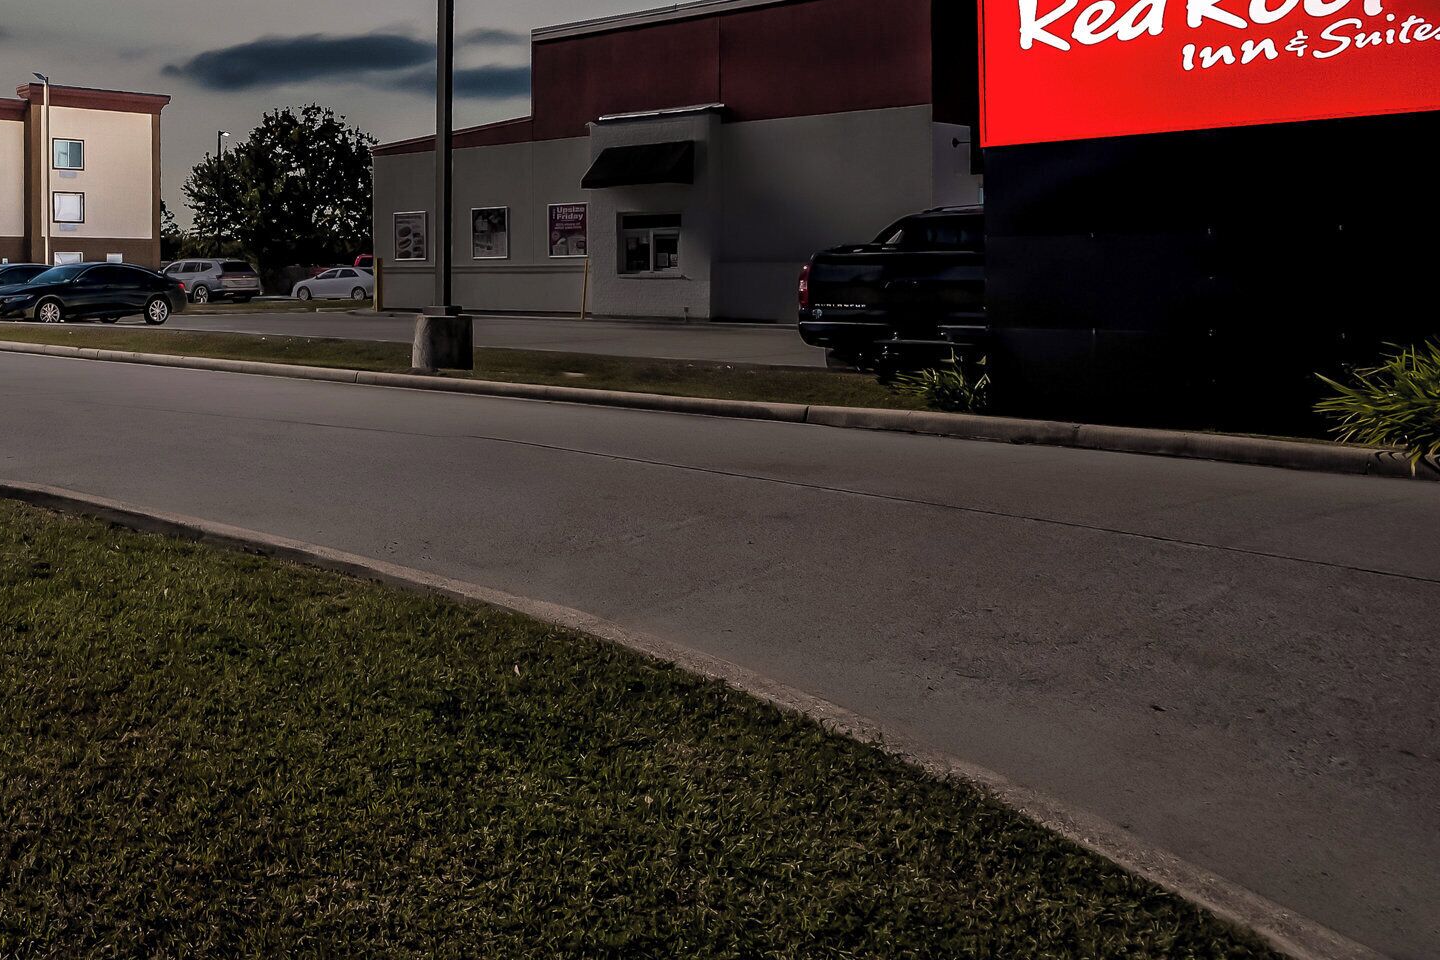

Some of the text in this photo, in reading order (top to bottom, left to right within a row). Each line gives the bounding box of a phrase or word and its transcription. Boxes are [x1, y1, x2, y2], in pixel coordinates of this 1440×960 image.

[1181, 38, 1279, 71] Inn
[1284, 30, 1310, 57] &
[556, 213, 584, 221] Friday
